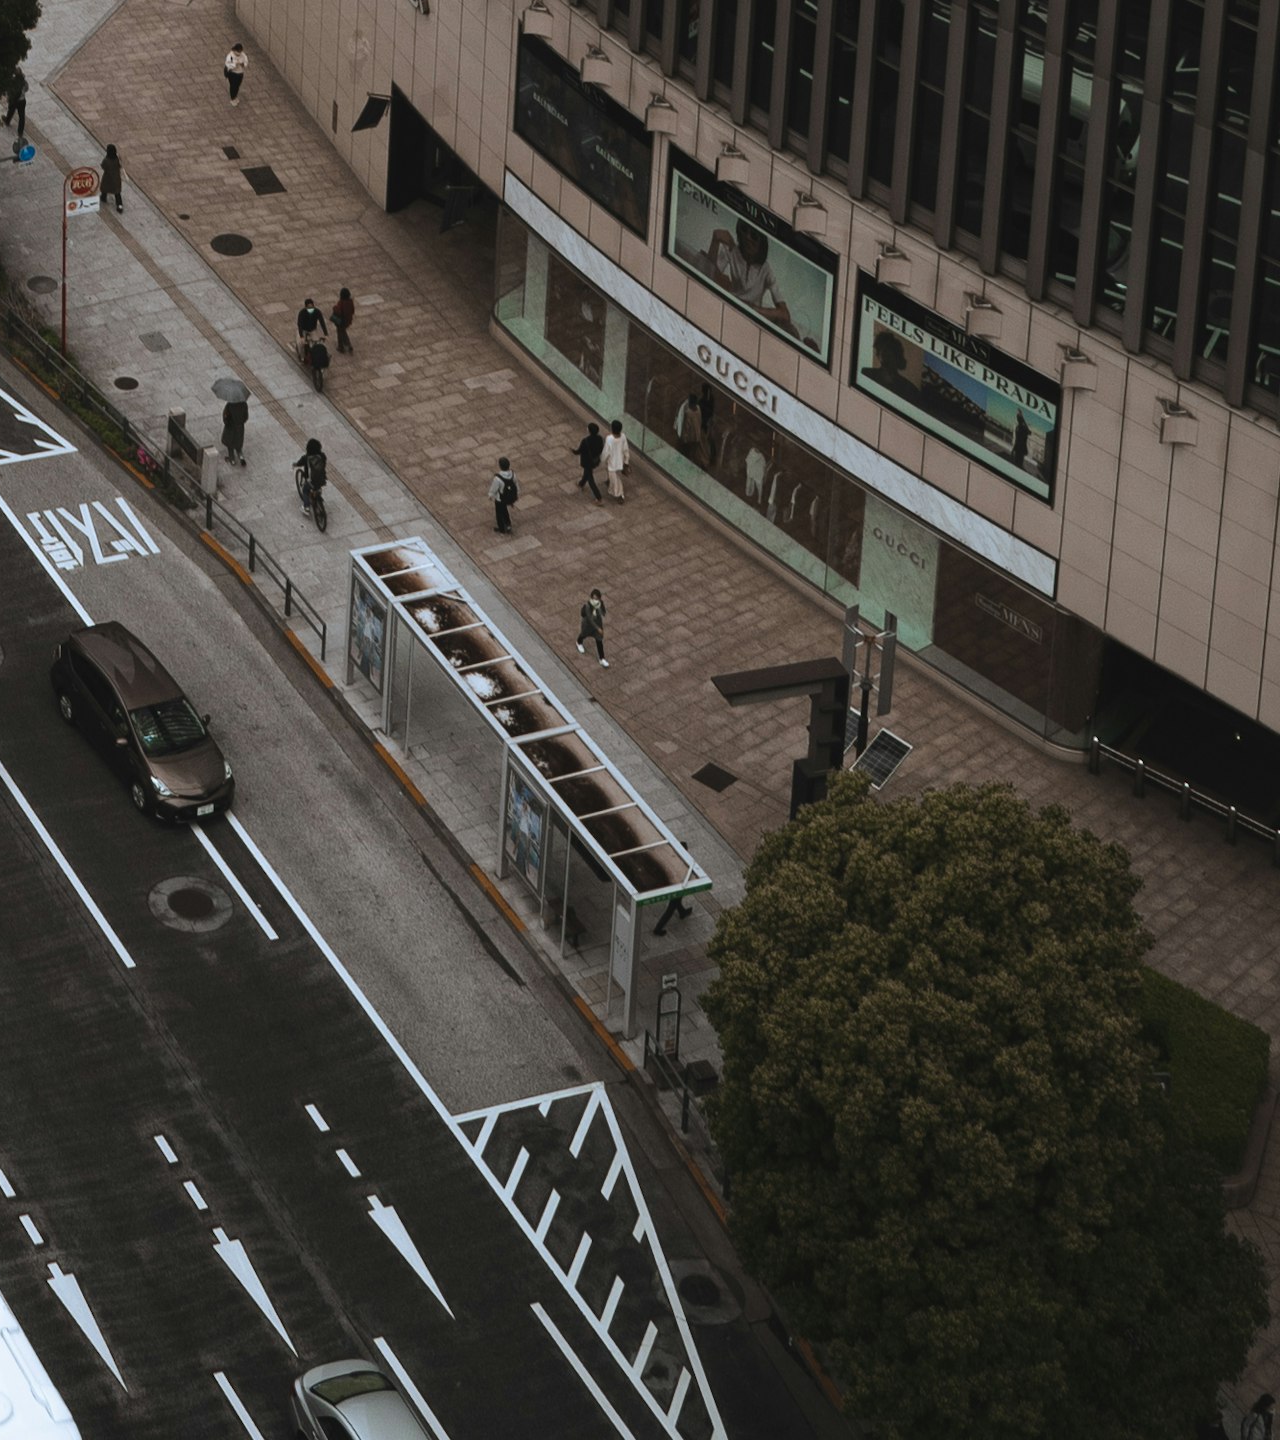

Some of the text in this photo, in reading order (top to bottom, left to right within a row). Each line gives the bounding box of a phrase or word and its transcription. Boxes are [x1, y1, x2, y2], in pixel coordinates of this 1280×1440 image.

[696, 343, 778, 415] GUCCI
[864, 298, 924, 345] FEELS
[930, 338, 976, 376] LIKE
[982, 365, 1053, 420] PRADA
[872, 526, 926, 570] GUCCI
